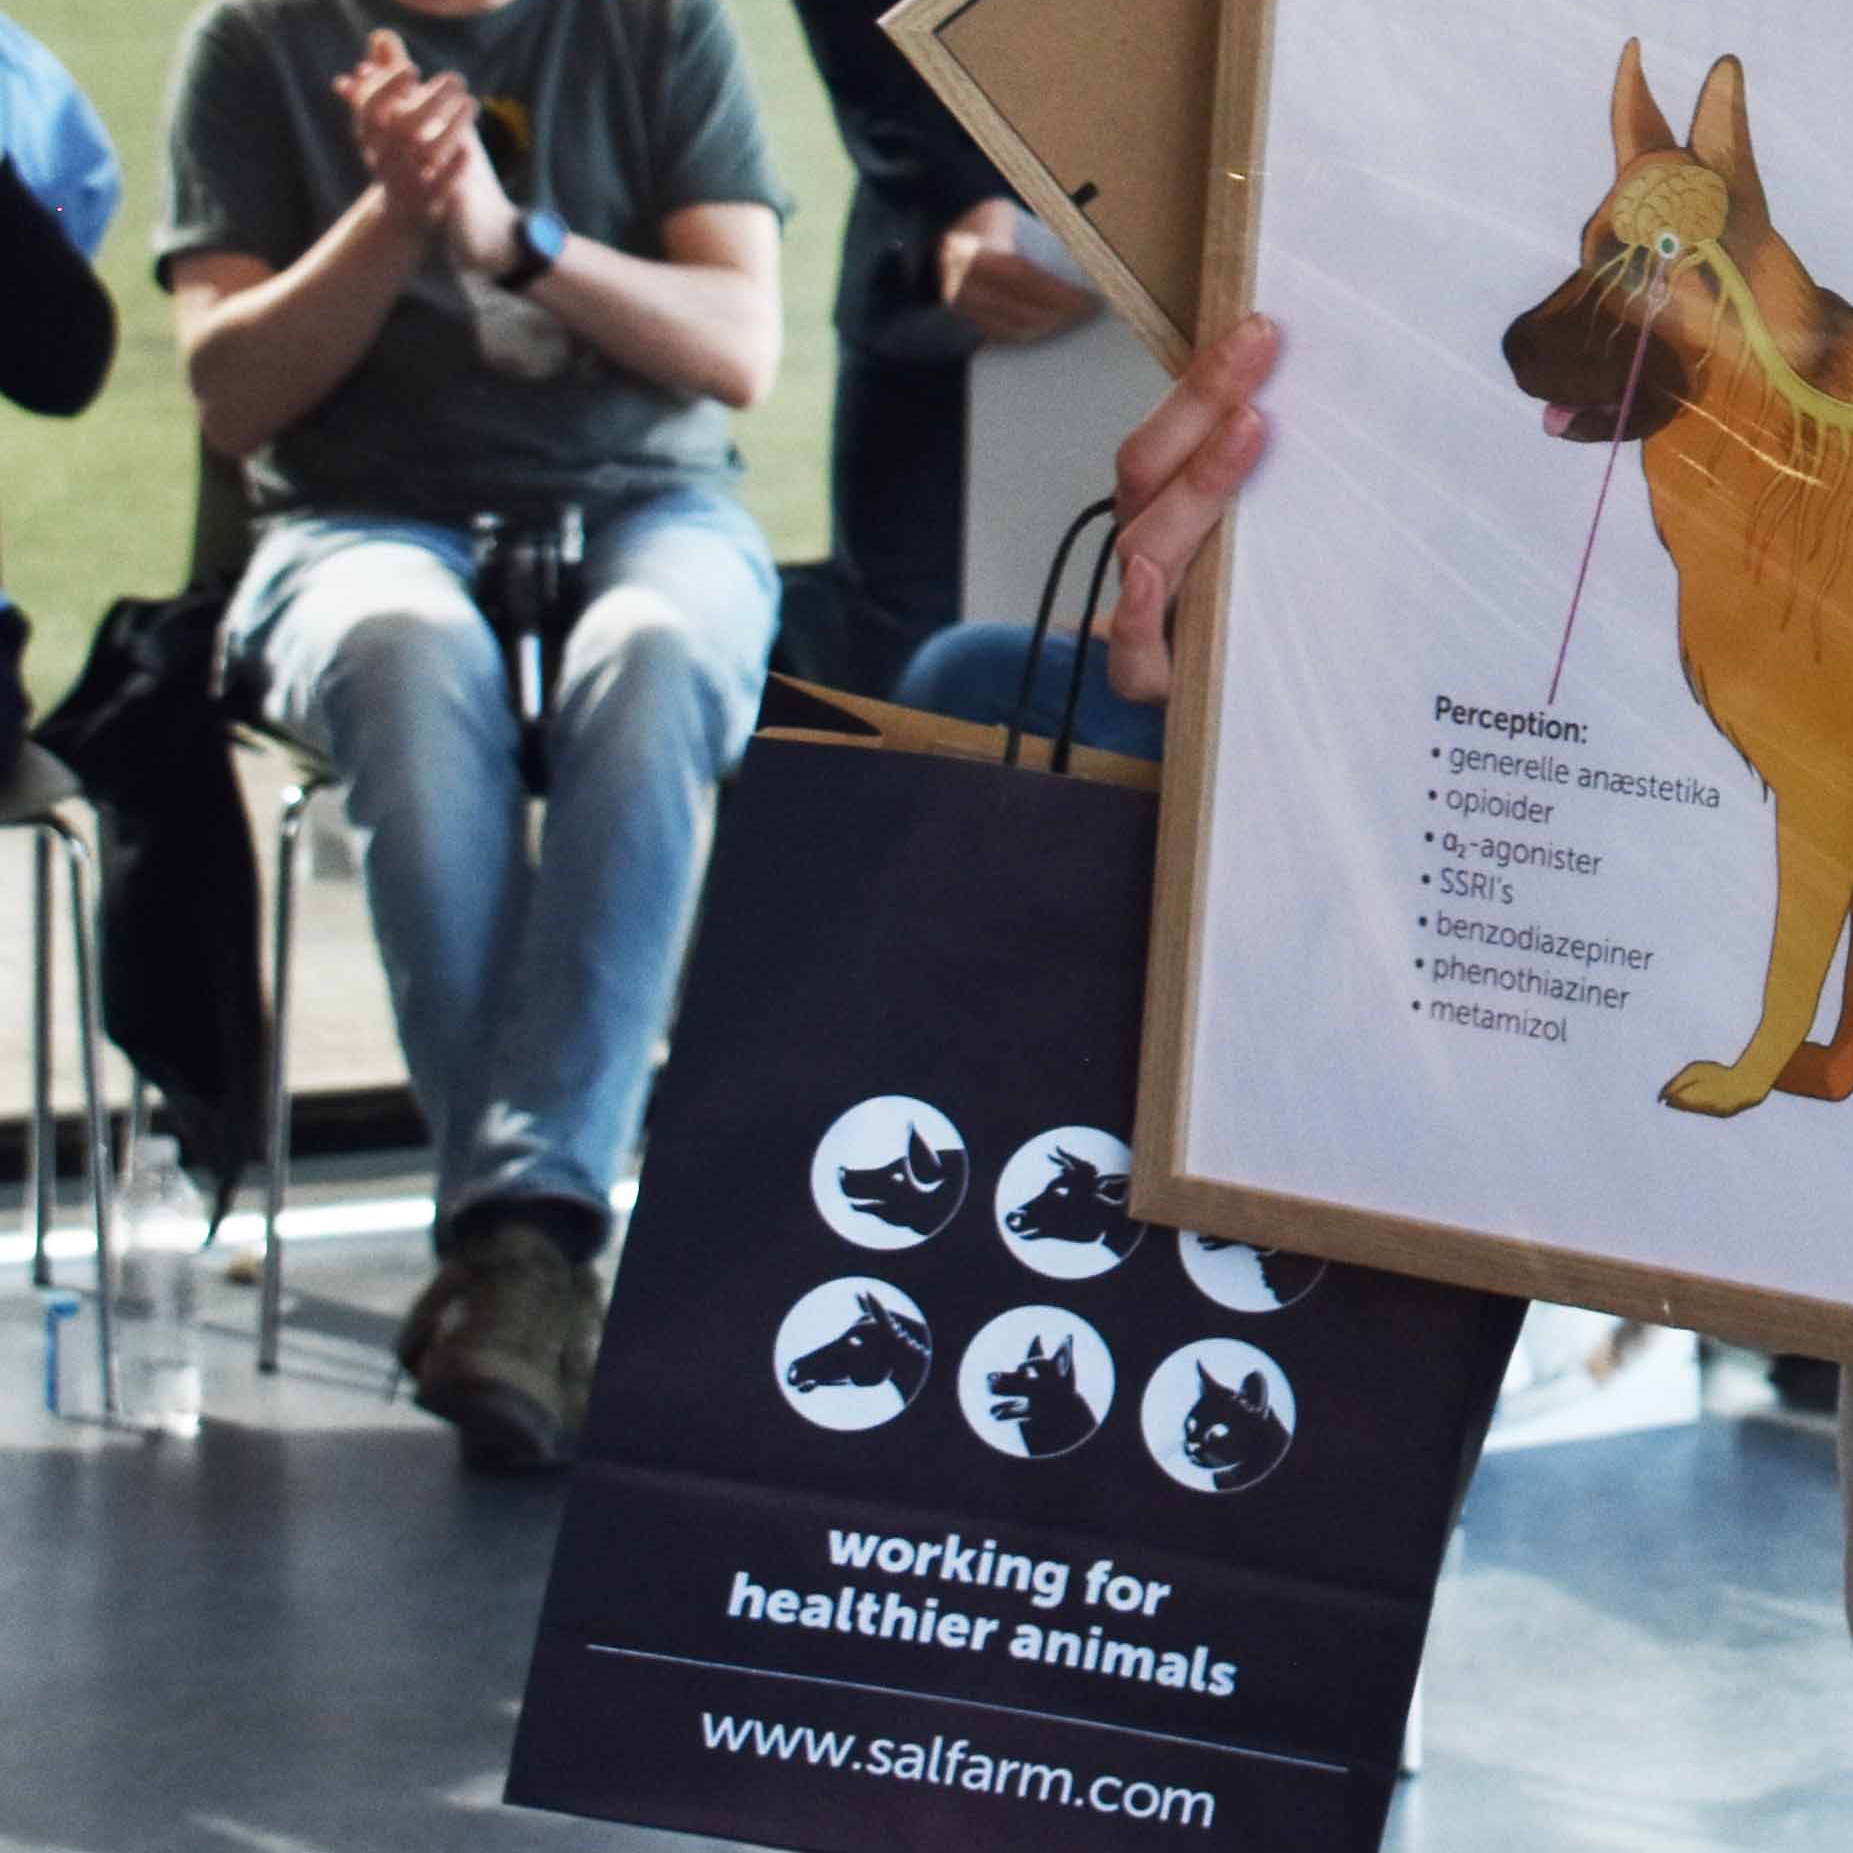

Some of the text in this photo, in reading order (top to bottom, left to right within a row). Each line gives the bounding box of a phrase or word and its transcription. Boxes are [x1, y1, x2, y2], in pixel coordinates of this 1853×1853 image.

[1434, 694, 1589, 744] Perception:
[1445, 788, 1555, 825] opioider
[1449, 746, 1721, 808] generelle anæstetika
[1439, 867, 1514, 905] SSRI's
[1436, 910, 1655, 971] benzodiazepiner
[1432, 954, 1631, 1011] phenothiaziner
[1429, 999, 1569, 1043] metamizol
[828, 1528, 1172, 1619] working for
[727, 1572, 1238, 1699] healthier animals
[700, 1710, 1216, 1830] www.salfarm.com
